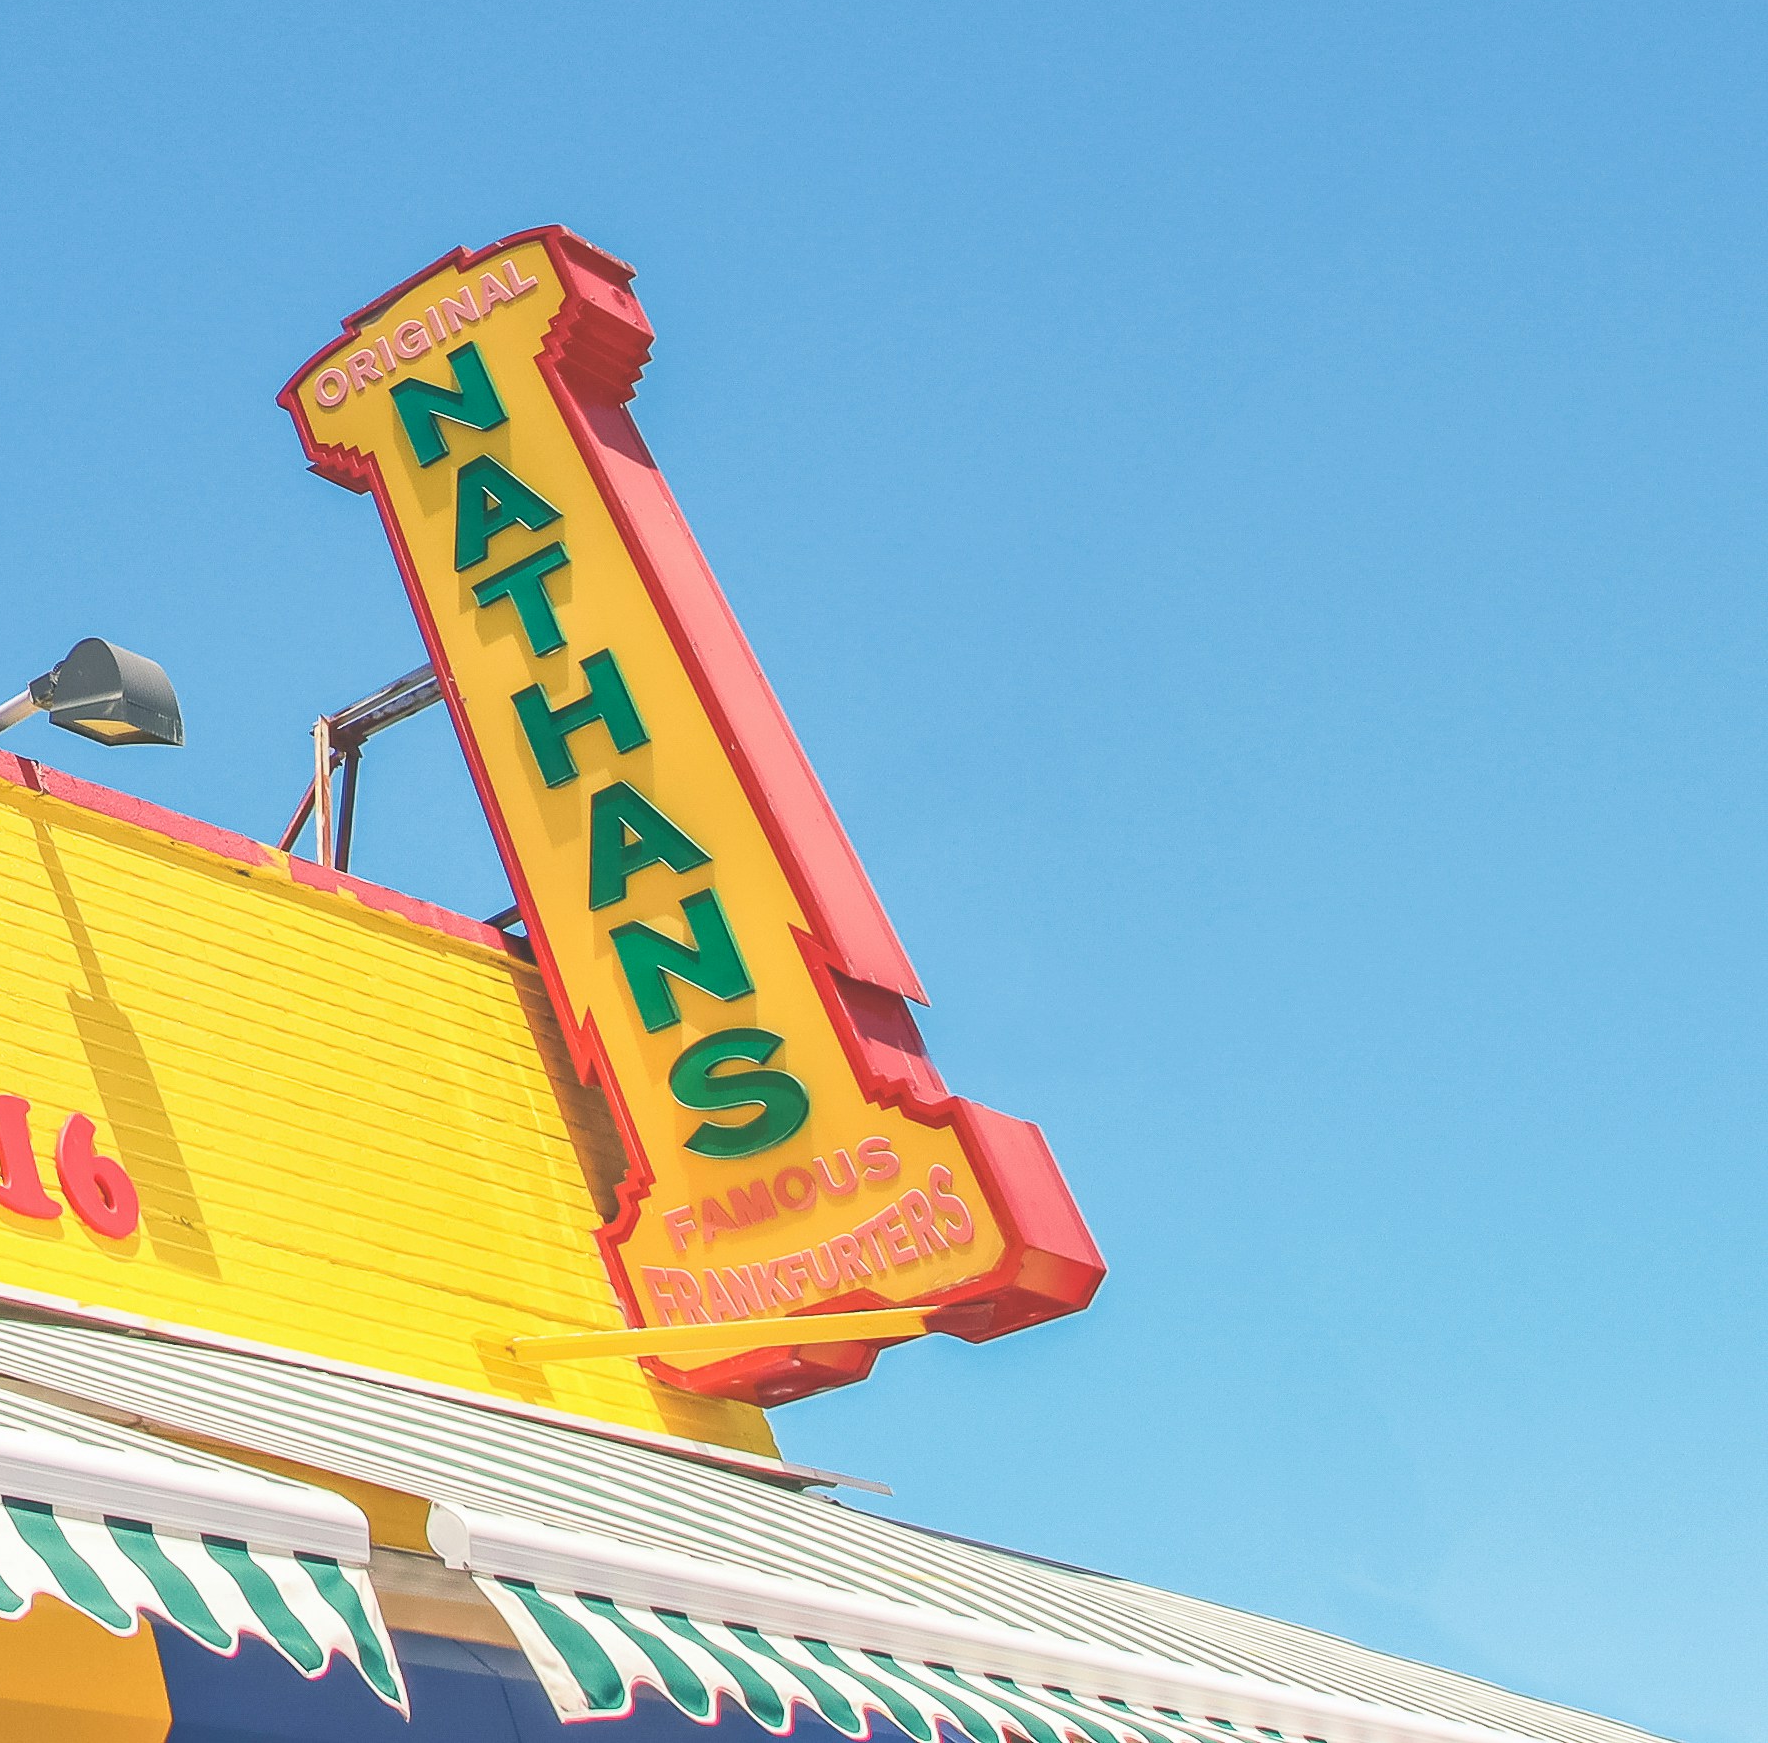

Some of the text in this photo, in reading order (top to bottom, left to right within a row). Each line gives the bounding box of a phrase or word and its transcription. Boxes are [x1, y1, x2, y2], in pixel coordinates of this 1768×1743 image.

[314, 259, 539, 408] ORIGINAL
[389, 341, 810, 1161] NATHANS
[640, 1162, 976, 1328] FRANKFURTERS
[662, 1135, 901, 1255] FAMOUS
